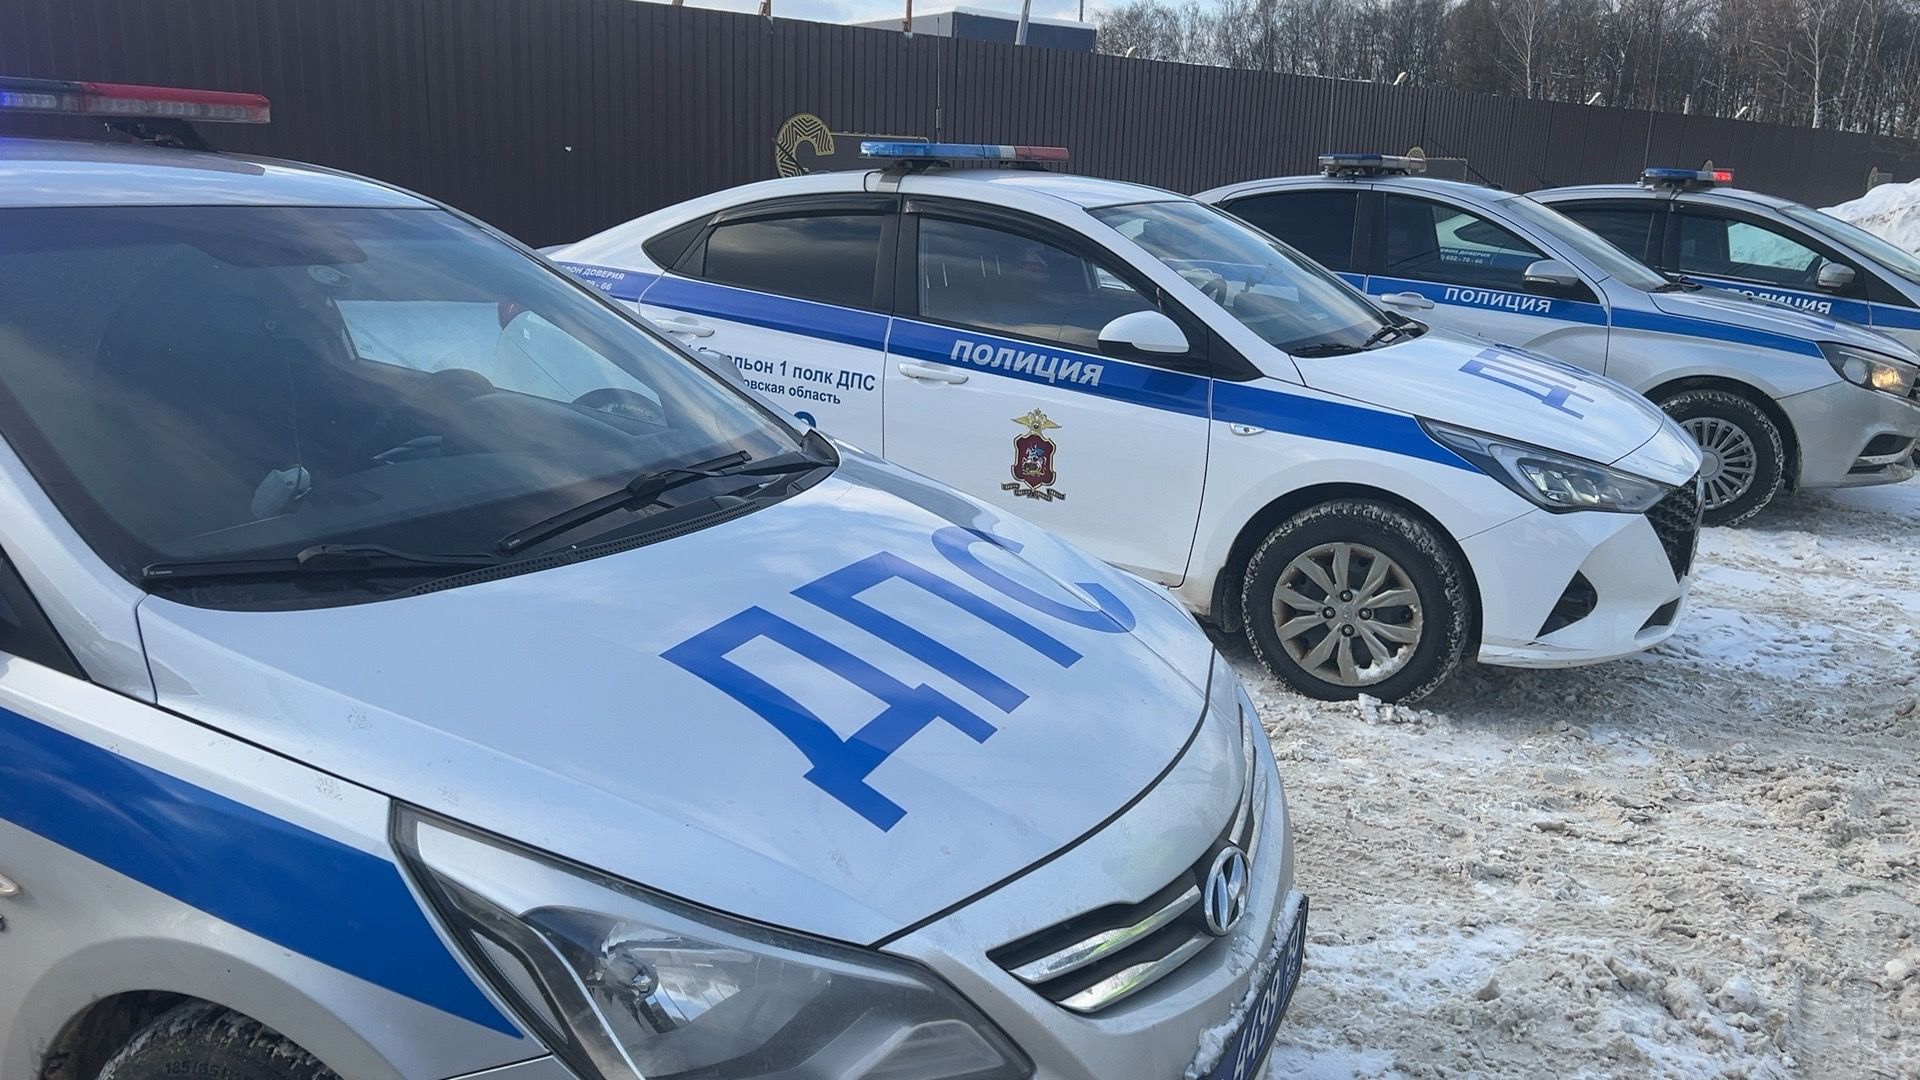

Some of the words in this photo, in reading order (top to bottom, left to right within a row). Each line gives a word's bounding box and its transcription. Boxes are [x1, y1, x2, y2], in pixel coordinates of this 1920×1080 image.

[582, 268, 625, 281] ДОВЕРИЯ
[1444, 286, 1552, 314] ПОЛИЦИЯ
[779, 360, 787, 377] 1
[793, 366, 833, 385] полк
[836, 370, 876, 391] ДПС
[950, 339, 1104, 387] ПОЛИЦИЯ
[744, 378, 785, 395] овская
[788, 385, 841, 405] область
[659, 526, 1136, 833] ДПС
